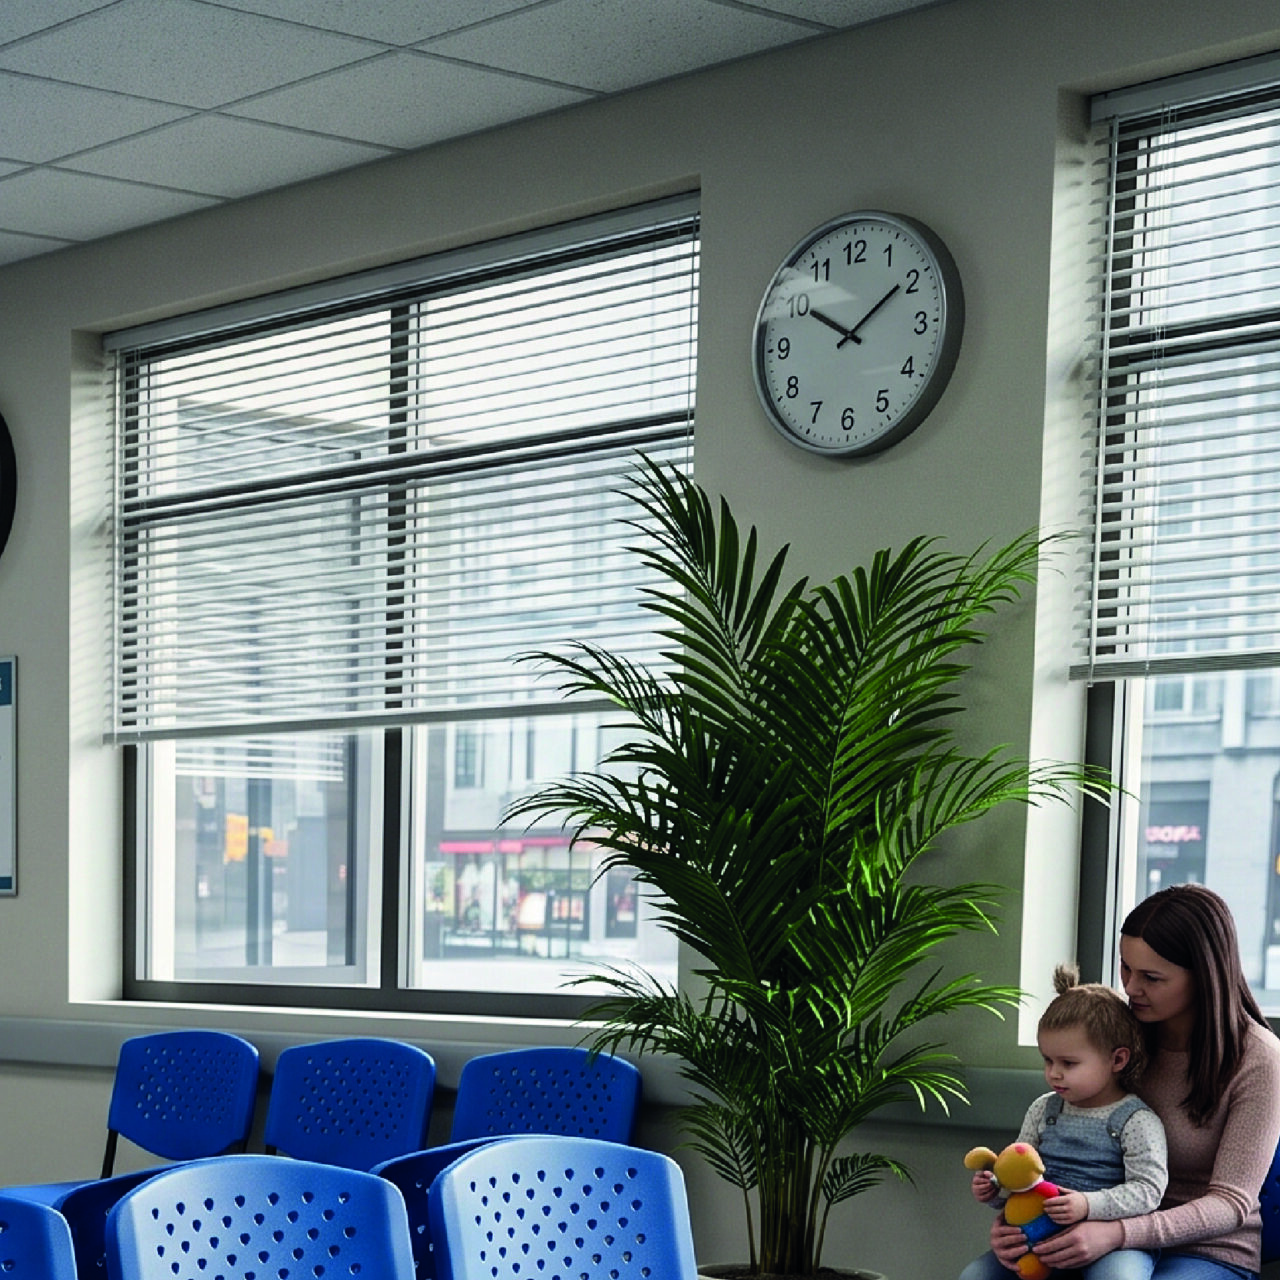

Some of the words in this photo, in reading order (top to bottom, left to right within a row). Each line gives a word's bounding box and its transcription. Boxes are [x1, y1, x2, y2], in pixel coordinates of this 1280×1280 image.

[843, 240, 867, 265] 12
[883, 244, 892, 267] 1
[810, 258, 830, 282] 11
[906, 269, 919, 294] 2
[786, 294, 809, 318] 10
[914, 311, 928, 335] 3
[777, 337, 790, 360] 9
[900, 355, 915, 378] 4
[786, 376, 799, 398] 8
[876, 389, 889, 412] 5
[810, 401, 823, 424] 7
[841, 408, 854, 431] 6
